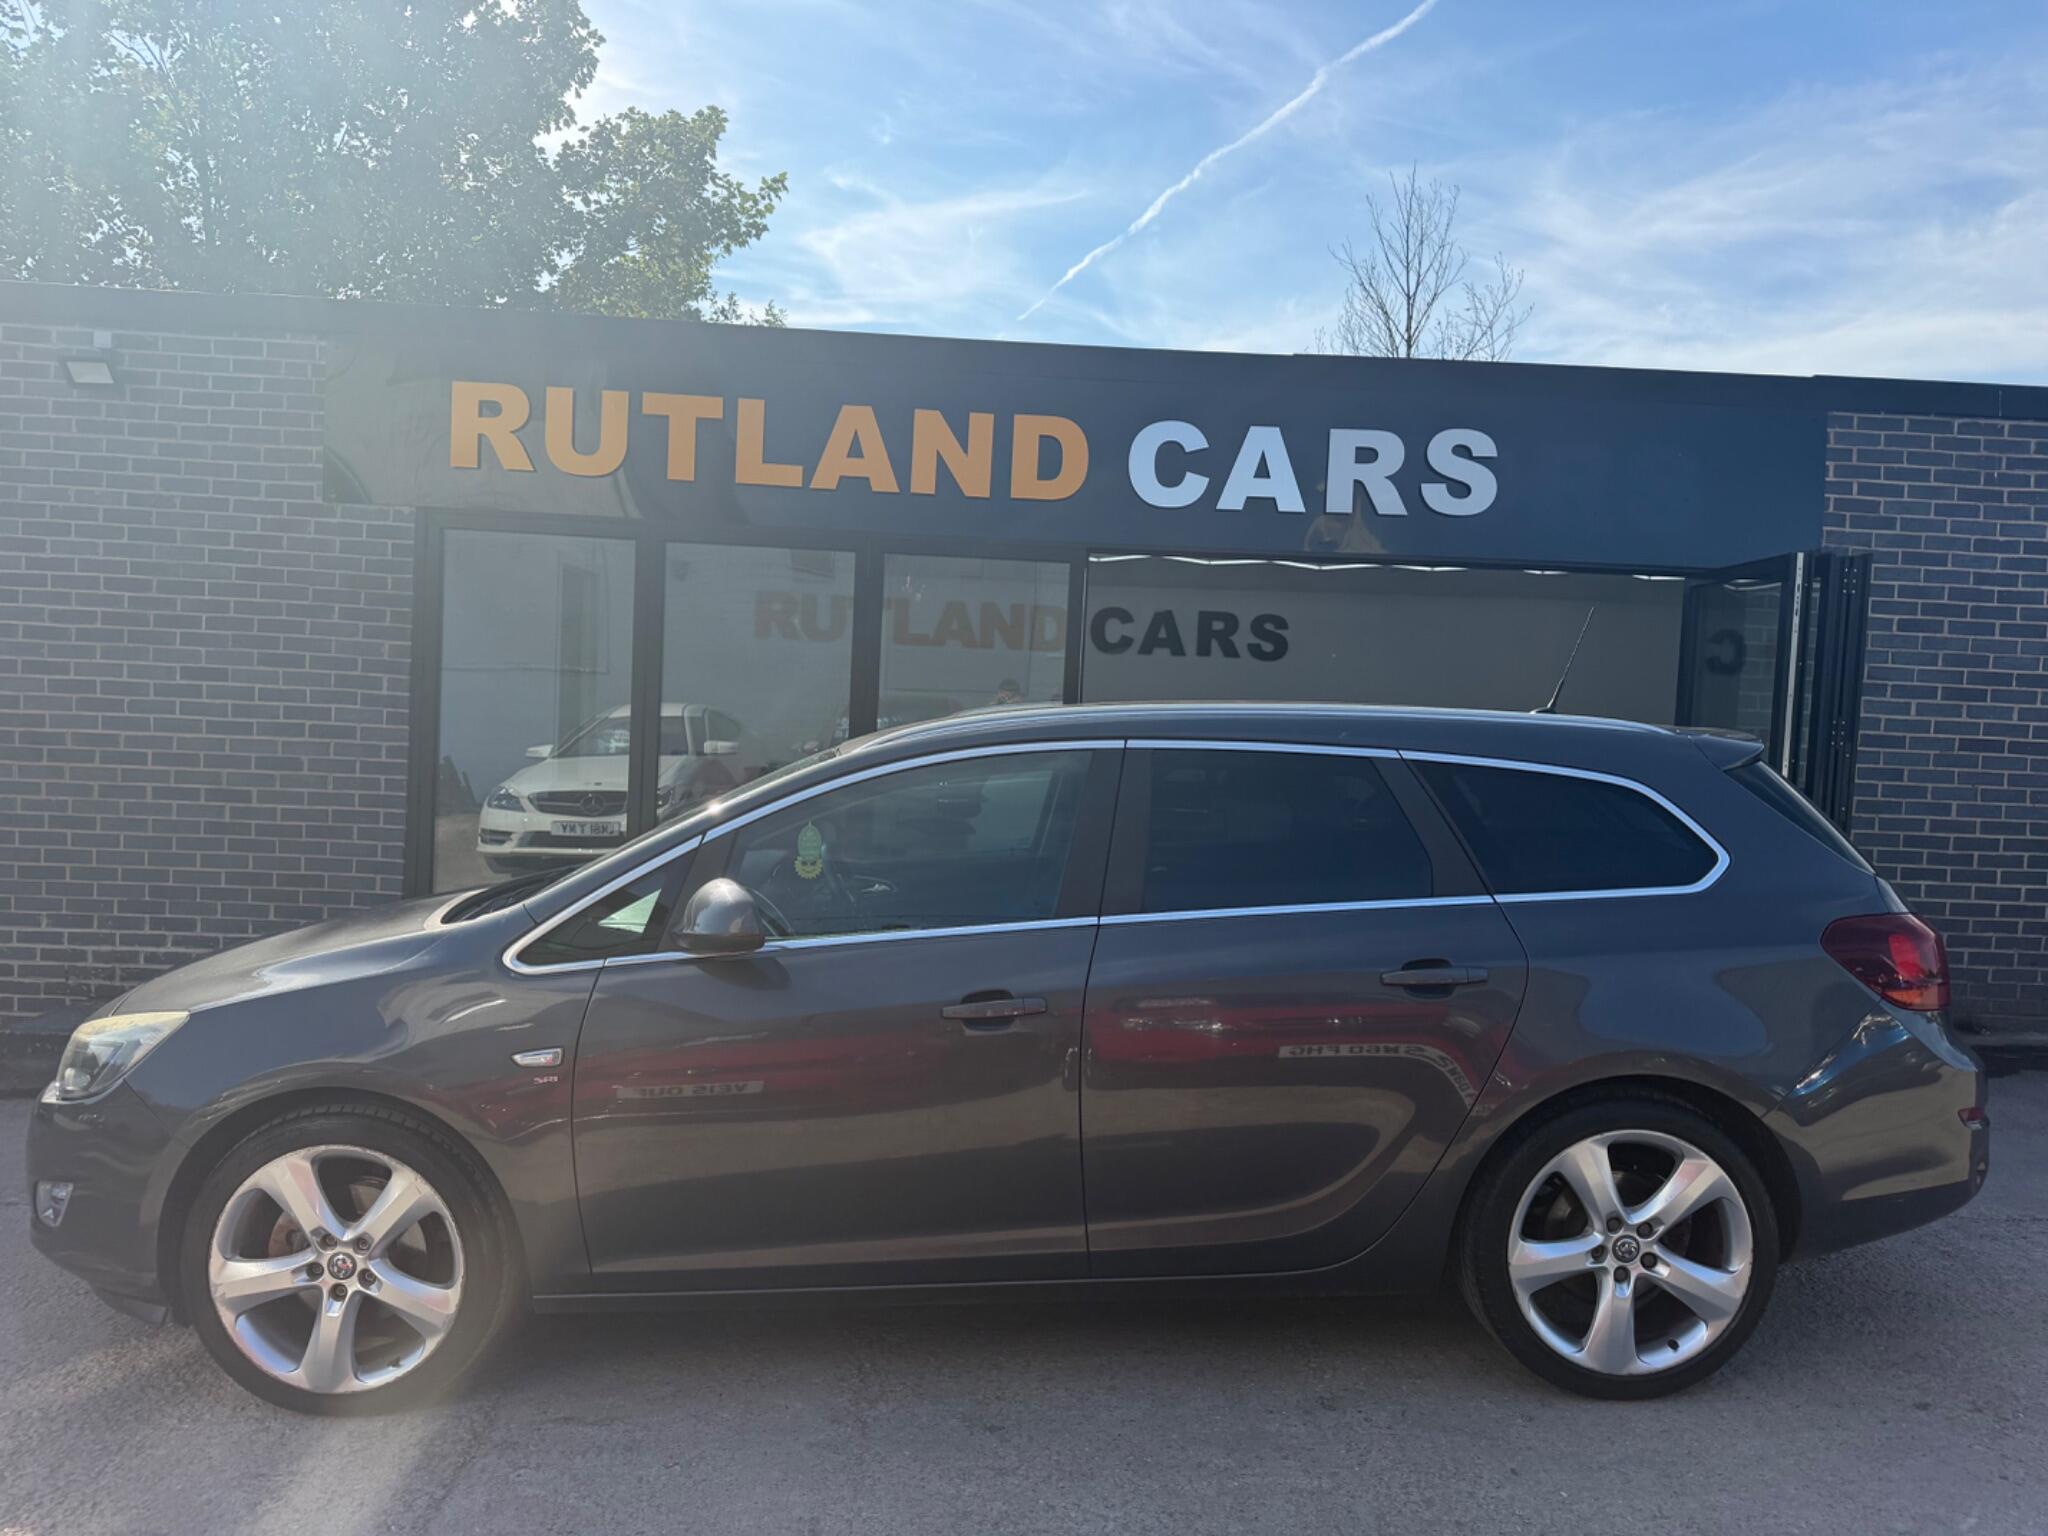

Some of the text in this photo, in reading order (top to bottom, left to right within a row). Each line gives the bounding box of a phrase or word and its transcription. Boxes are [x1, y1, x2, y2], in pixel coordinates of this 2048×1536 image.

[449, 379, 1499, 517] RUTLAND CARS
[753, 591, 1290, 662] RULAND CARS
